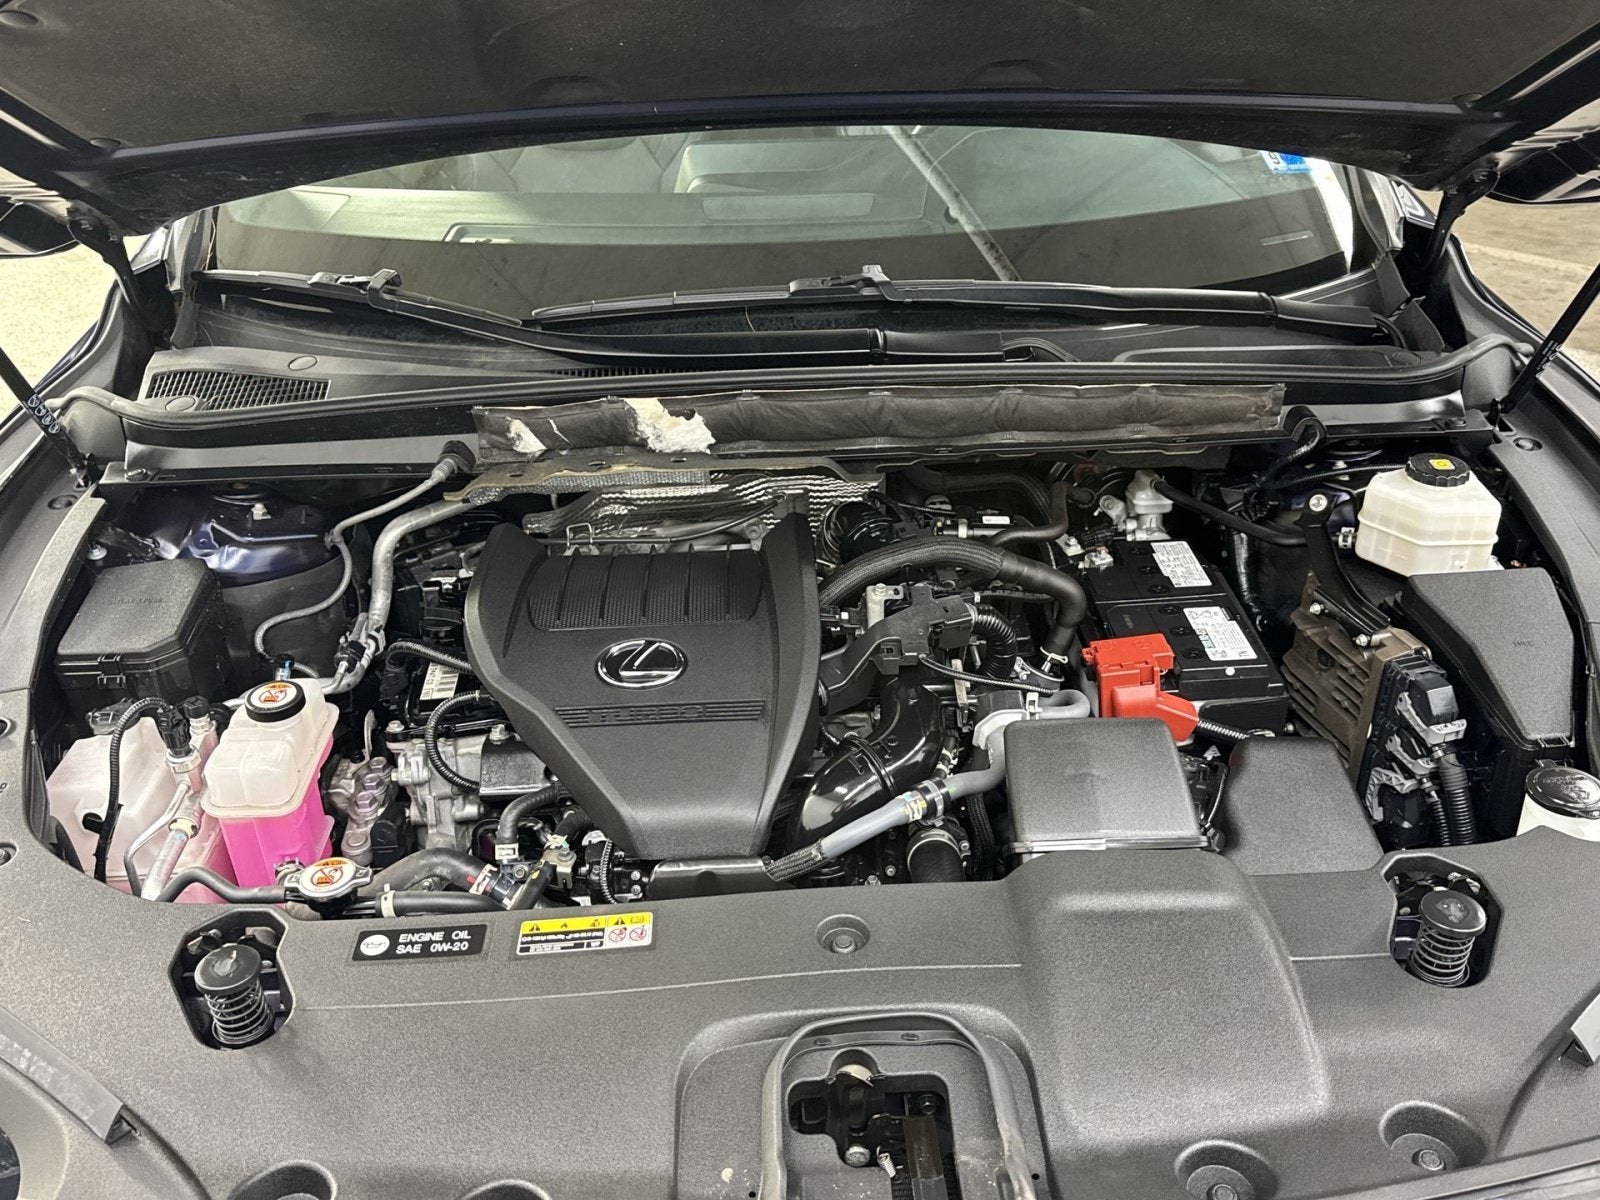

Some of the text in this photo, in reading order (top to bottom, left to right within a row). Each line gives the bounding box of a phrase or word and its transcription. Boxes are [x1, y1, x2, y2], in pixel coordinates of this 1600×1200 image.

[398, 930, 472, 943] ENGINE OIL
[395, 941, 470, 955] SAE 0W-20
